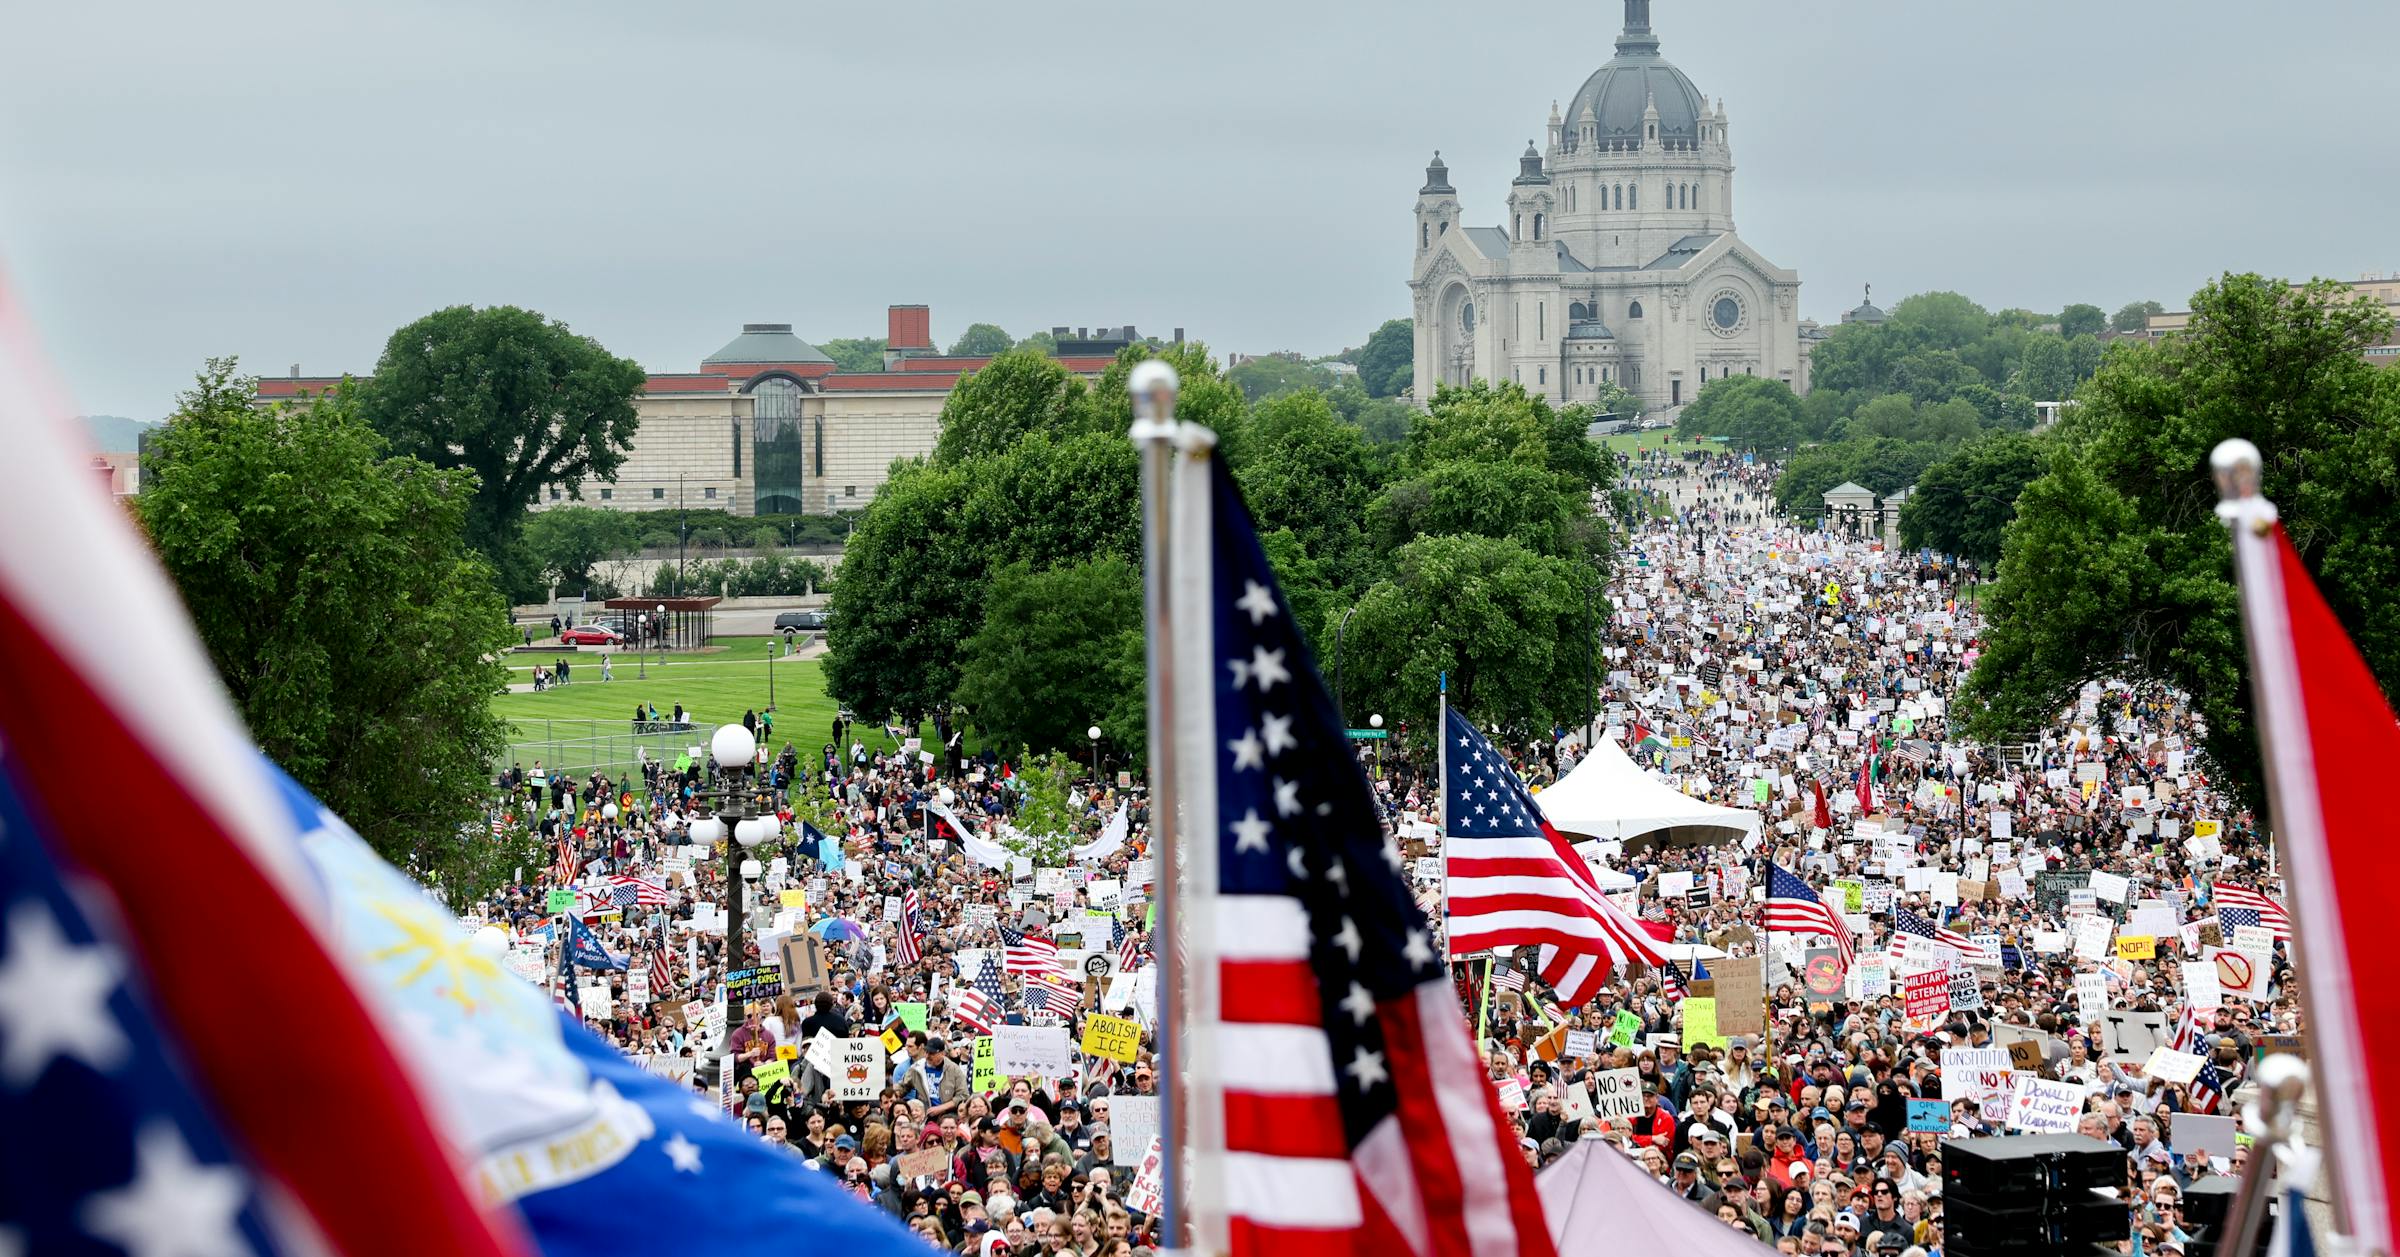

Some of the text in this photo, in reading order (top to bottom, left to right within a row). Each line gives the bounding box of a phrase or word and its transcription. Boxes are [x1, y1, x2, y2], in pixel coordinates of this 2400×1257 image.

[1874, 838, 1886, 848] NO
[1874, 850, 1892, 859] KING
[727, 969, 756, 980] RESPECT
[727, 978, 751, 988] RIGHTS
[758, 973, 781, 984] EXPECT
[1905, 971, 1947, 988] MILITARY
[1948, 972, 1972, 981] NO
[743, 983, 780, 998] FIGHT
[1906, 984, 1948, 1001] VETERAN
[1950, 988, 1977, 998] NO
[688, 1002, 700, 1012] NO
[1952, 996, 1980, 1007] FASCISTS
[1091, 1019, 1137, 1039] ABOLISH
[850, 1042, 863, 1051] NO
[1094, 1035, 1127, 1055] ICE
[844, 1054, 873, 1063] KINGS
[2010, 1048, 2028, 1064] NO
[757, 1067, 784, 1078] IMPEACH
[1599, 1076, 1617, 1095] NO
[1979, 1073, 1998, 1088] NO
[2024, 1079, 2075, 1102] DONALD
[1601, 1097, 1640, 1117] KING
[2032, 1098, 2070, 1116] LOVES
[1120, 1113, 1161, 1123] SCIEN
